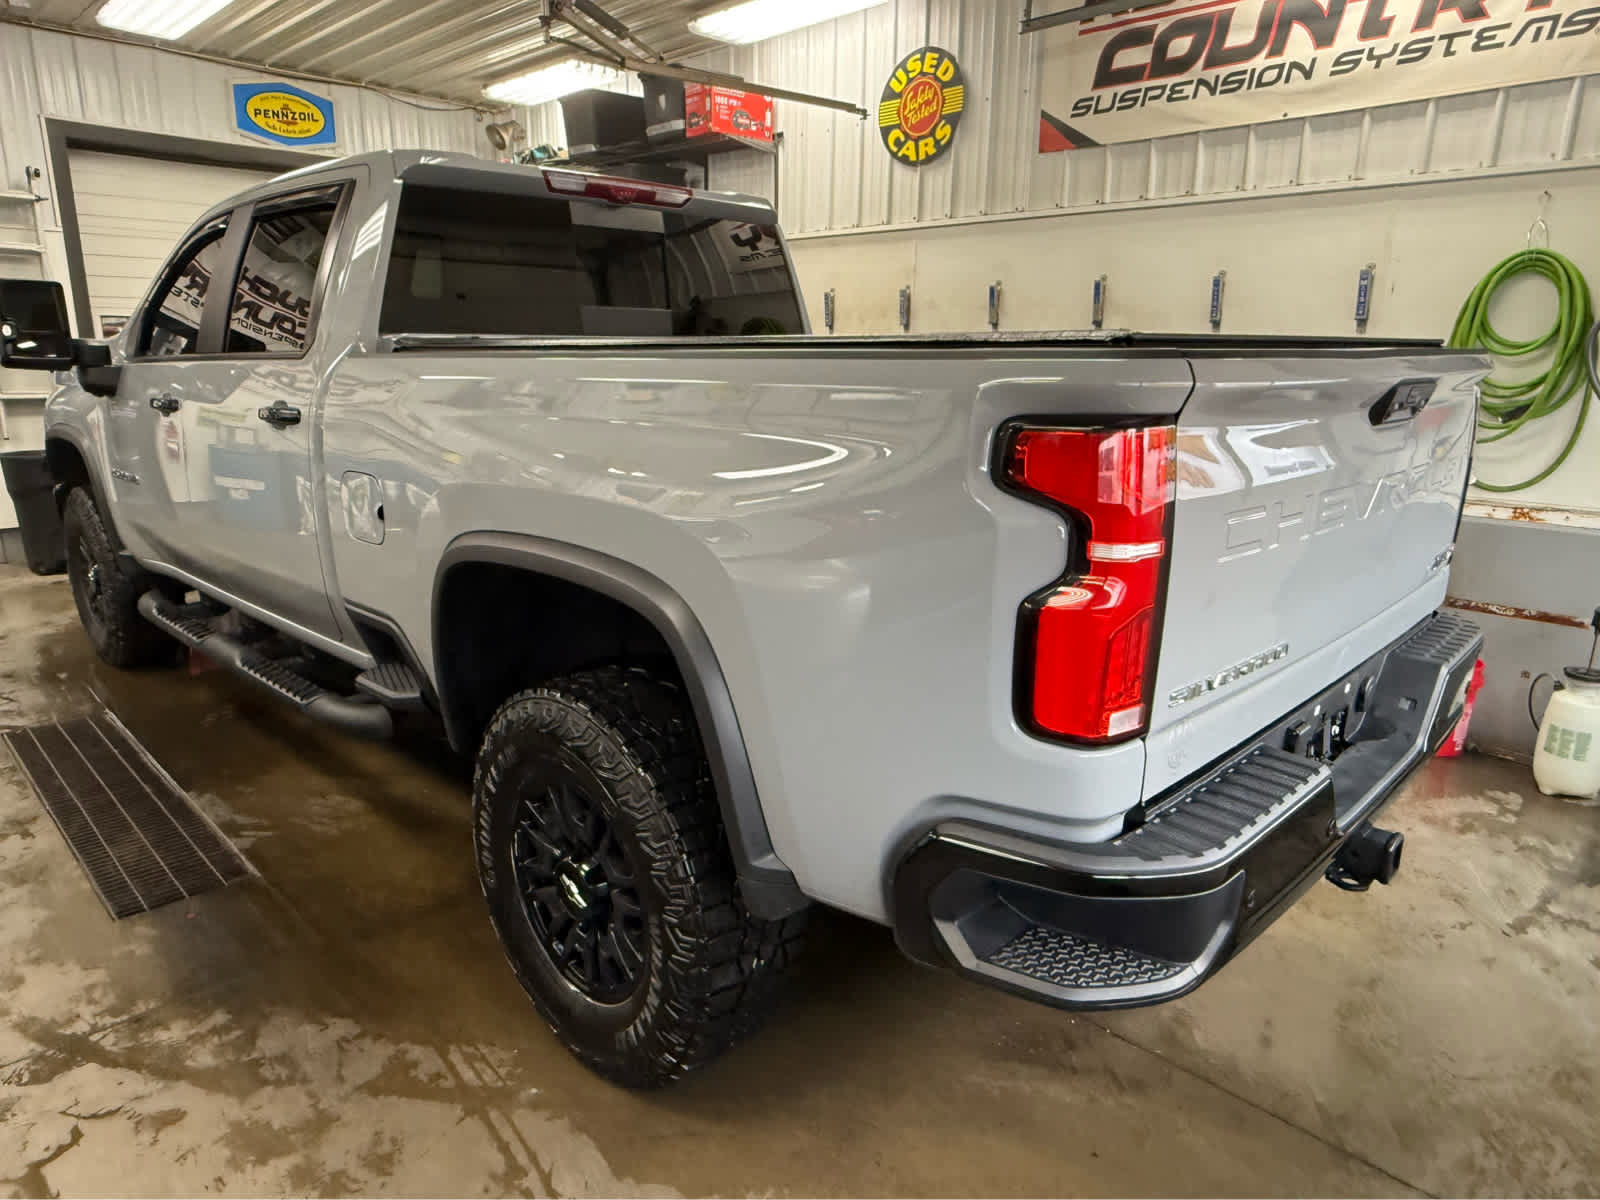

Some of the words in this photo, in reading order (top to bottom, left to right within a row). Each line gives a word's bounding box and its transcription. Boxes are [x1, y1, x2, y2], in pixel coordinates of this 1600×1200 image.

[1070, 56, 1318, 119] SUSPENSION
[1329, 6, 1600, 77] SYSTEMS
[1090, 0, 1552, 91] COUNT
[888, 51, 955, 94] USED
[253, 107, 320, 123] PENNZOIL
[887, 119, 952, 161] CARS
